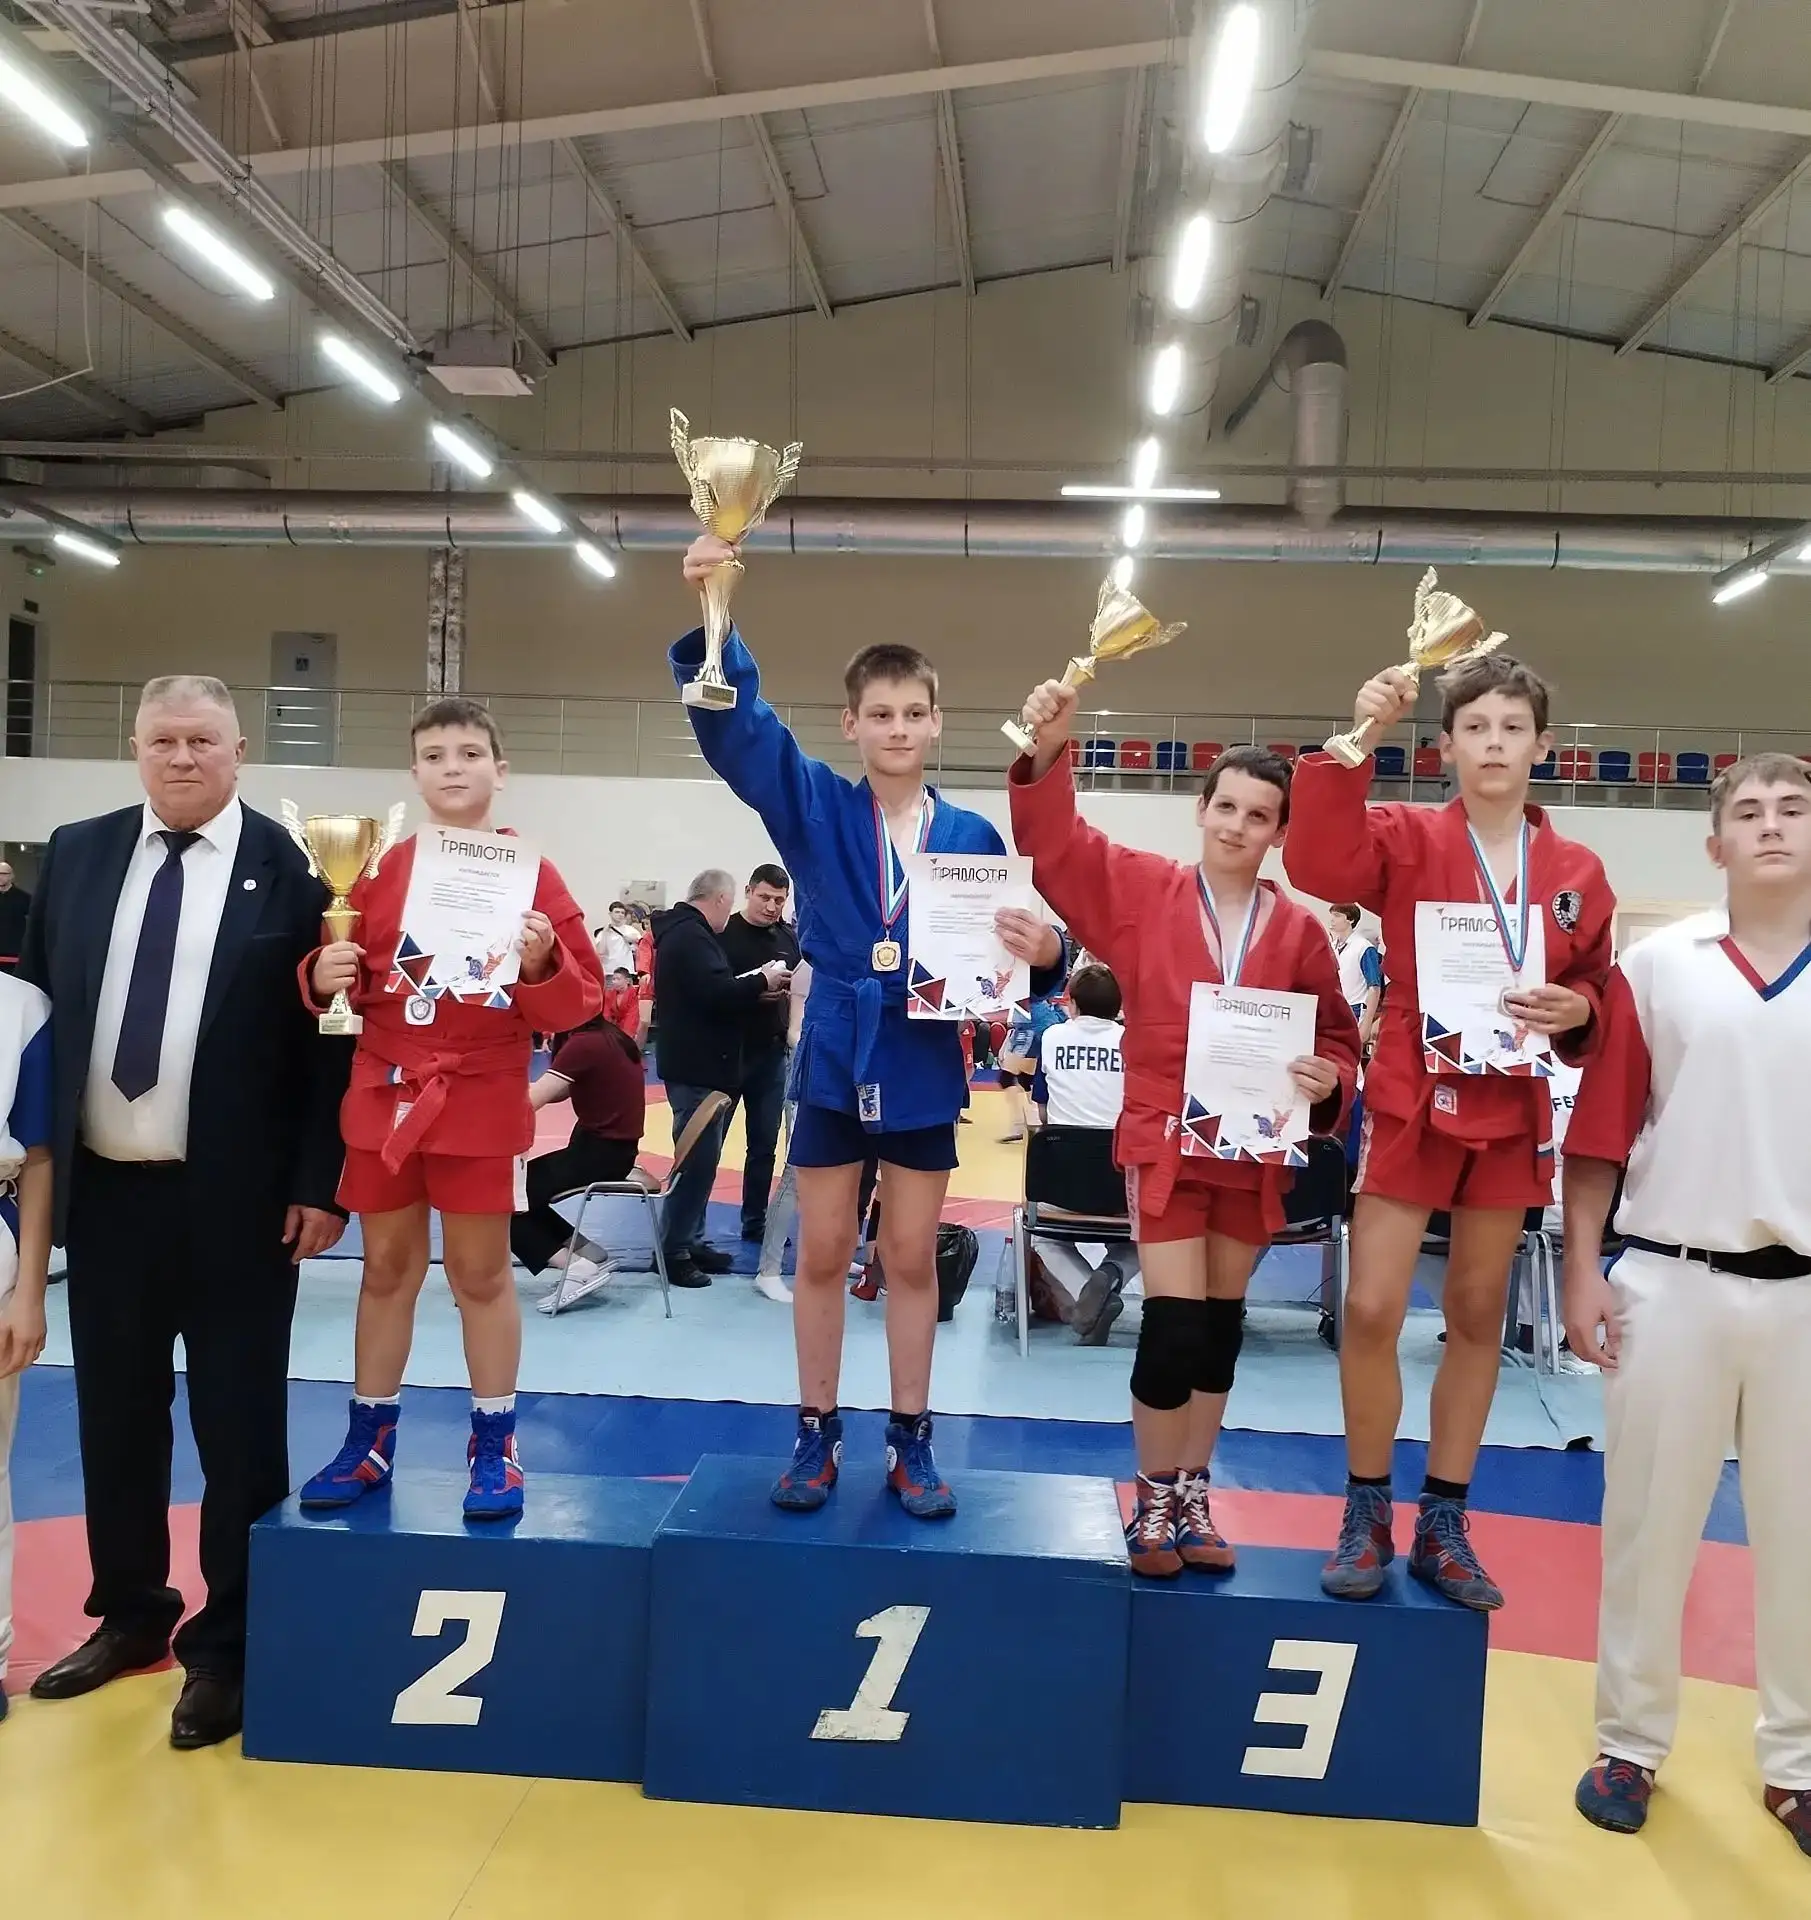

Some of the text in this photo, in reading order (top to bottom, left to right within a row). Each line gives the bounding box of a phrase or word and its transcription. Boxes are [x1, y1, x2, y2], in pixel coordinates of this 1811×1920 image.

[441, 839, 516, 864] ГРАМОТА
[932, 866, 1008, 883] ГРАМОТА
[1055, 1045, 1125, 1072] REFERE
[391, 1589, 507, 1726] 2
[808, 1604, 931, 1742] 1
[1239, 1638, 1359, 1780] 3
